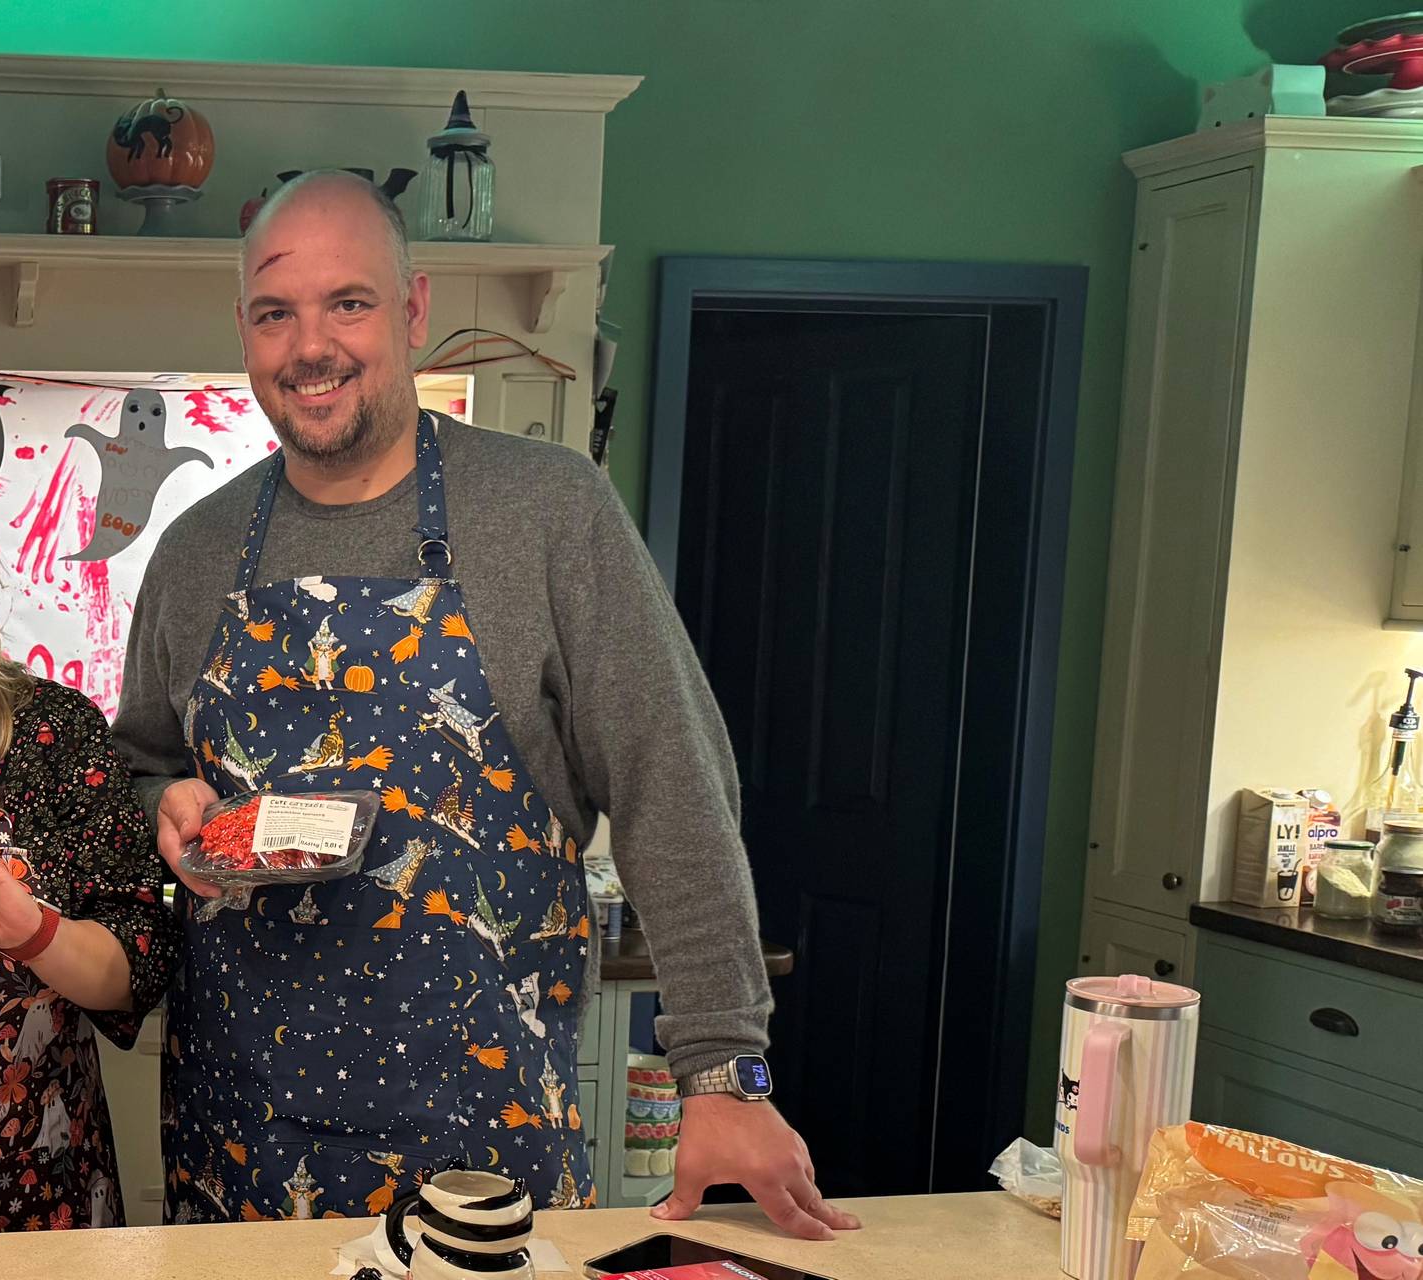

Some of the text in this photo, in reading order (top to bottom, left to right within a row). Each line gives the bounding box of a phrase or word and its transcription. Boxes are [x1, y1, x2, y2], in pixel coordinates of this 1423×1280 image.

[101, 512, 142, 537] BOO!
[1308, 827, 1338, 841] alpro
[1277, 844, 1296, 852] VANILLE
[752, 1064, 768, 1087] 12:34
[1056, 1121, 1070, 1134] NDS
[1202, 1125, 1346, 1179] MALLOWS
